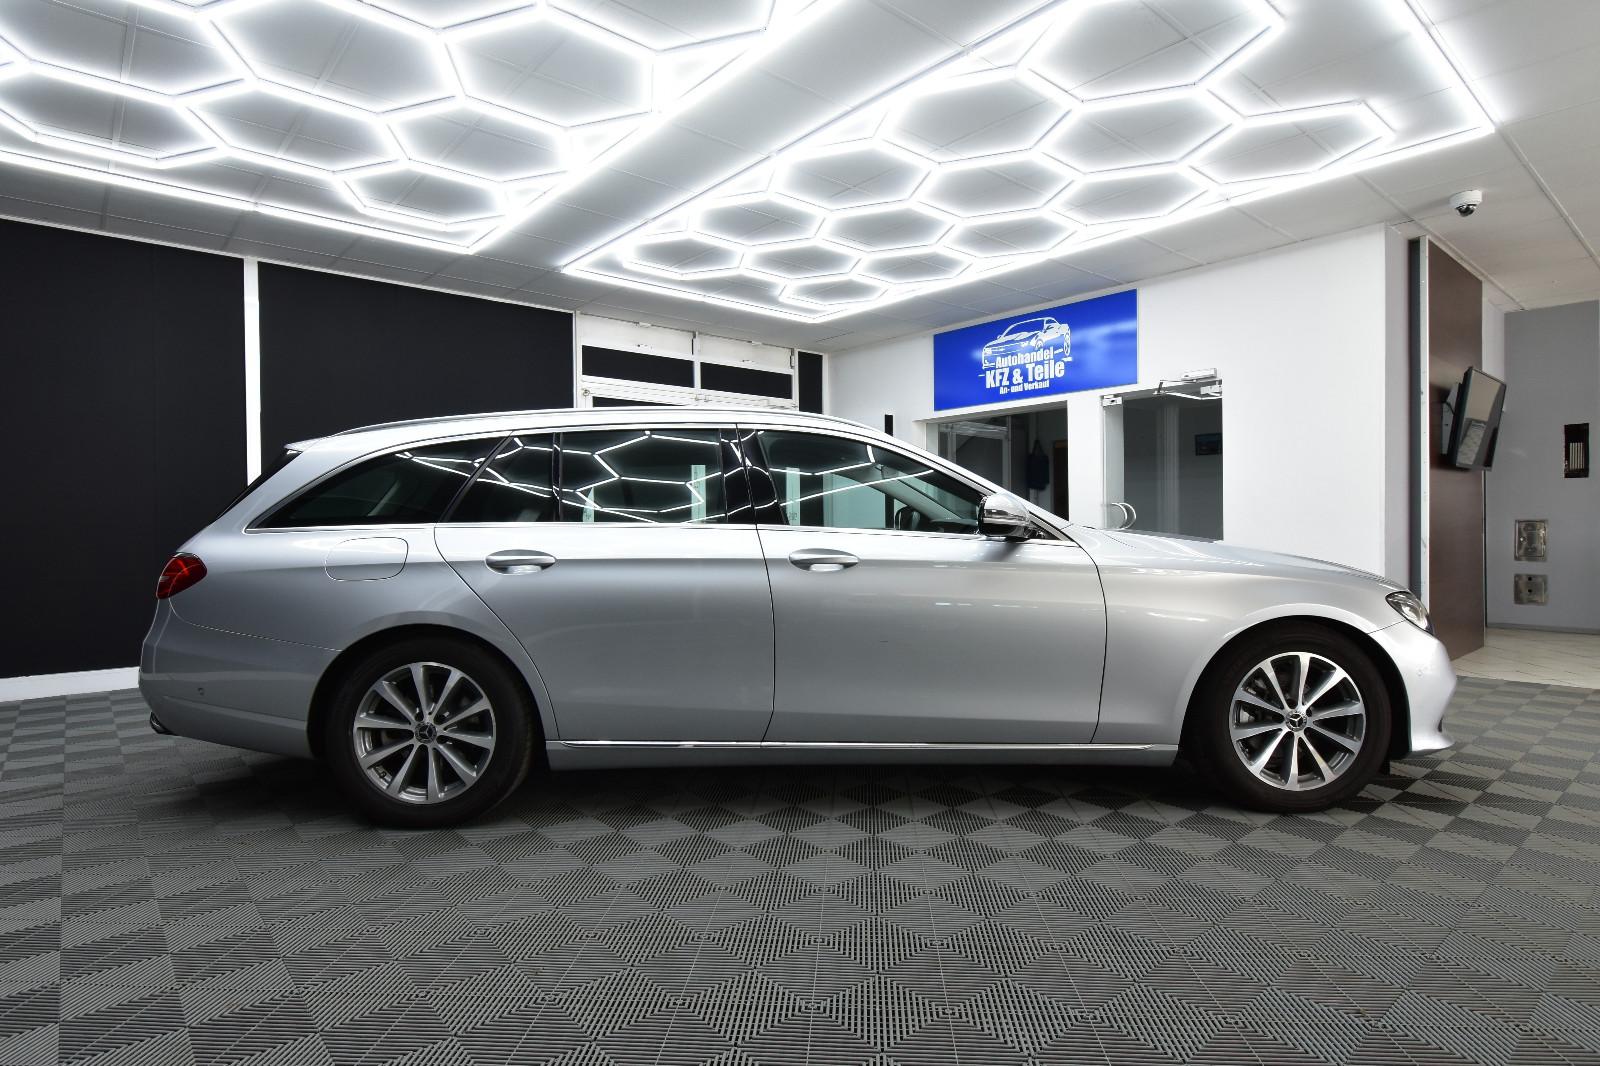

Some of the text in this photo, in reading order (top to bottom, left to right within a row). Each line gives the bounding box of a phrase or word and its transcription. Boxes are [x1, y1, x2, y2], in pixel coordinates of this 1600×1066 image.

[996, 346, 1054, 368] Autohandel
[986, 359, 1065, 389] KFZ & Teile
[999, 380, 1050, 394] An- und Verkauf
